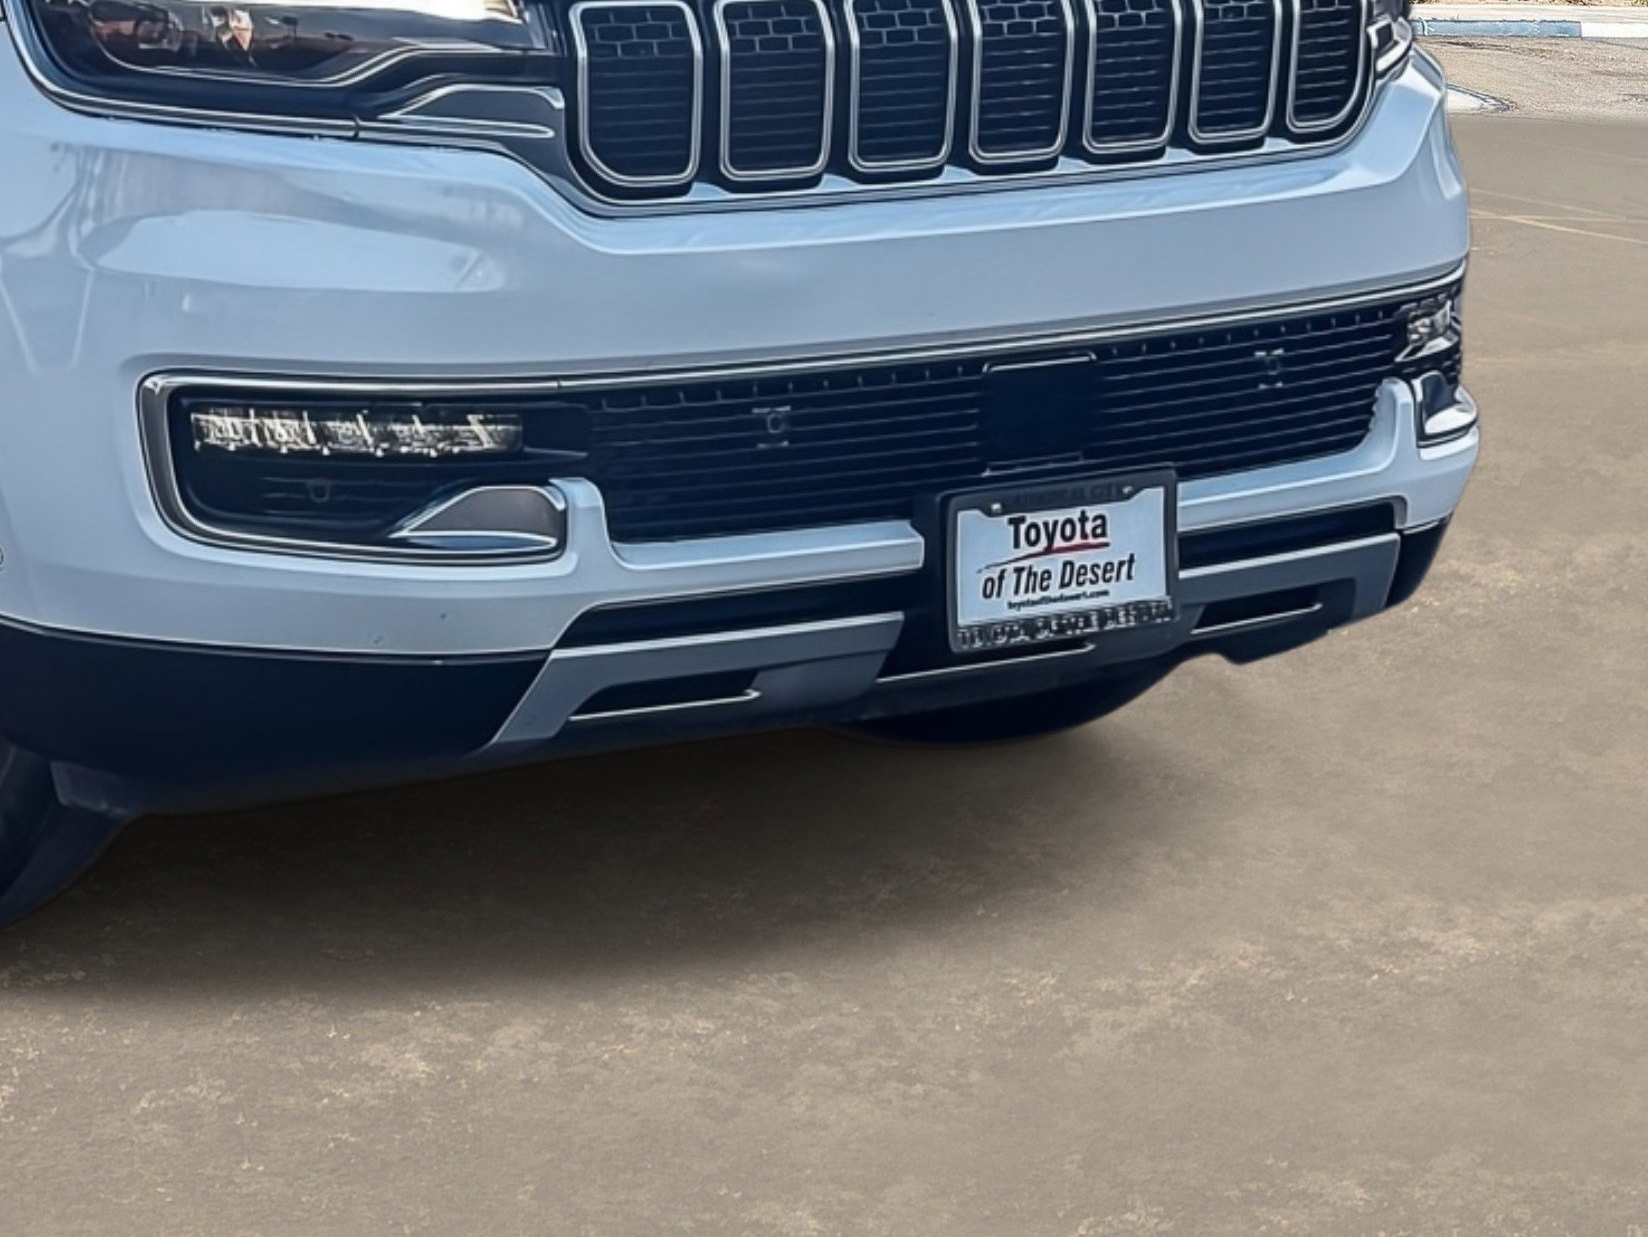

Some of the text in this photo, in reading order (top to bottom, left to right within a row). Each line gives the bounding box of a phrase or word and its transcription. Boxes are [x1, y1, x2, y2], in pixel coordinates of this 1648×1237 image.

[1007, 509, 1108, 552] Toyota
[982, 553, 1137, 600] of The Desert
